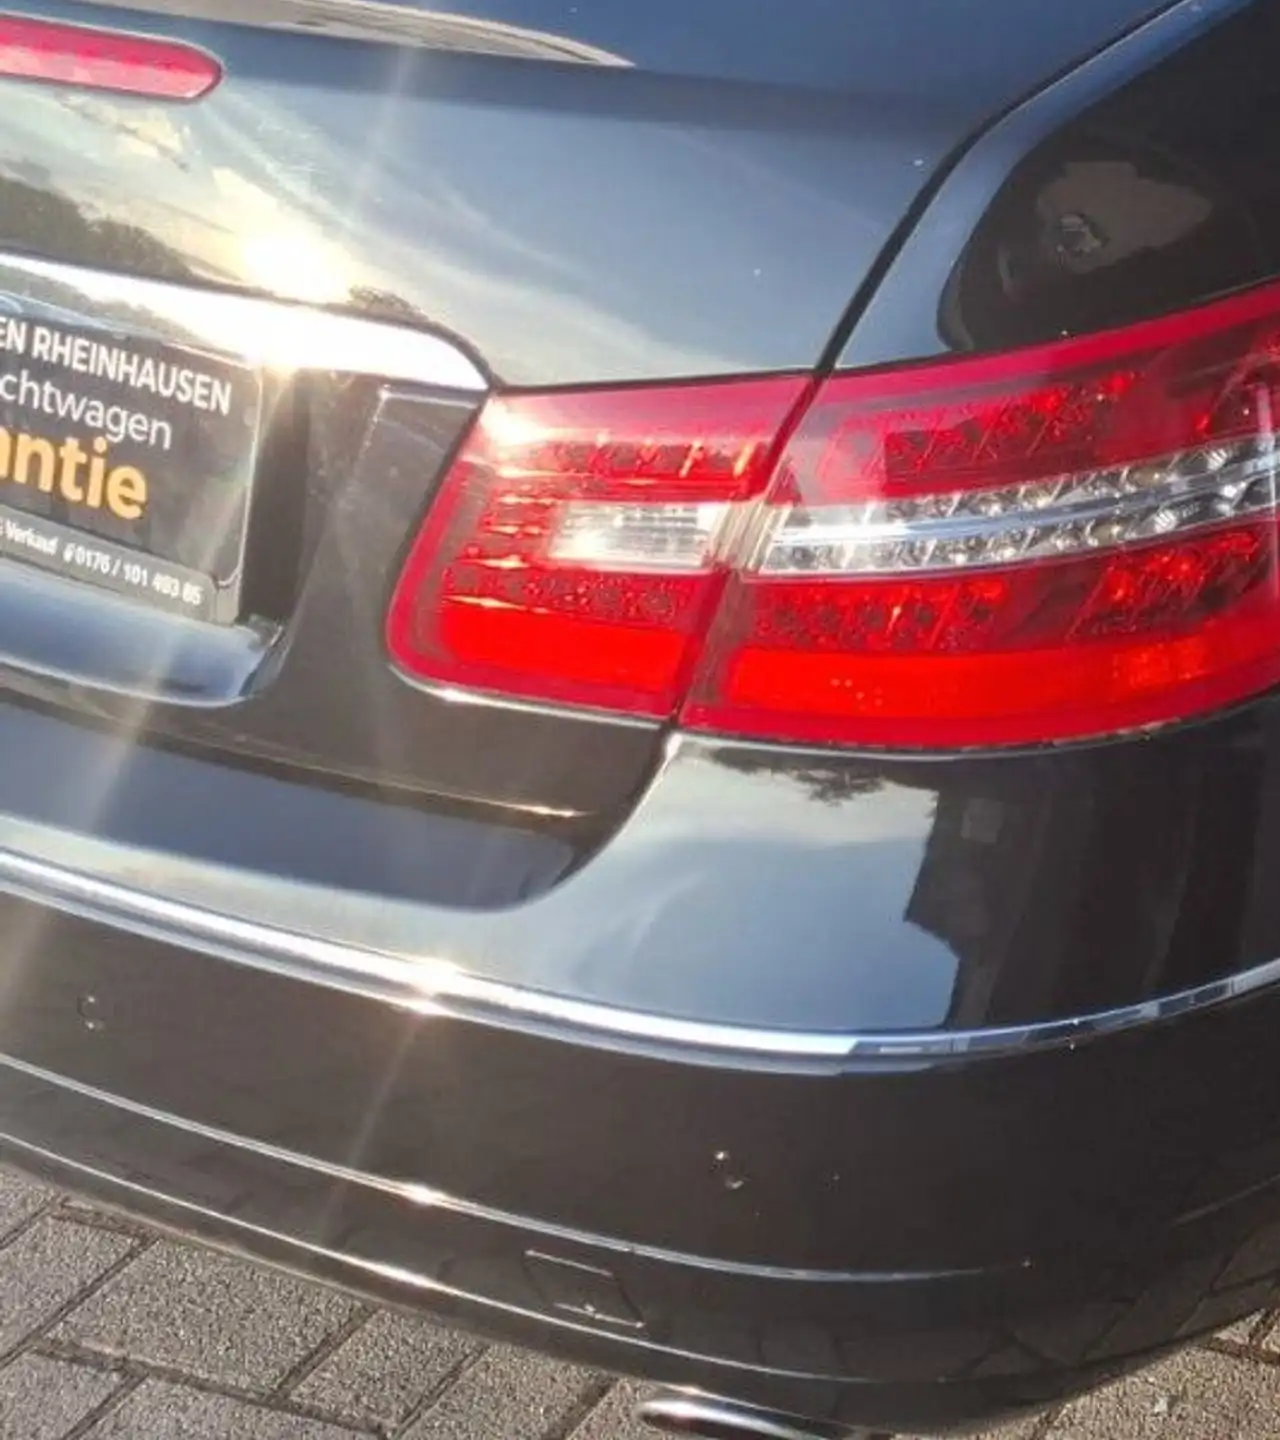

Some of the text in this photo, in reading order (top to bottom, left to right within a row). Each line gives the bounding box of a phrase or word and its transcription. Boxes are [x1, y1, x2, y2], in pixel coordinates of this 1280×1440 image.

[0, 369, 173, 450] chtwagen
[31, 326, 232, 414] RHEINHAUSEN
[0, 426, 148, 520] ntie
